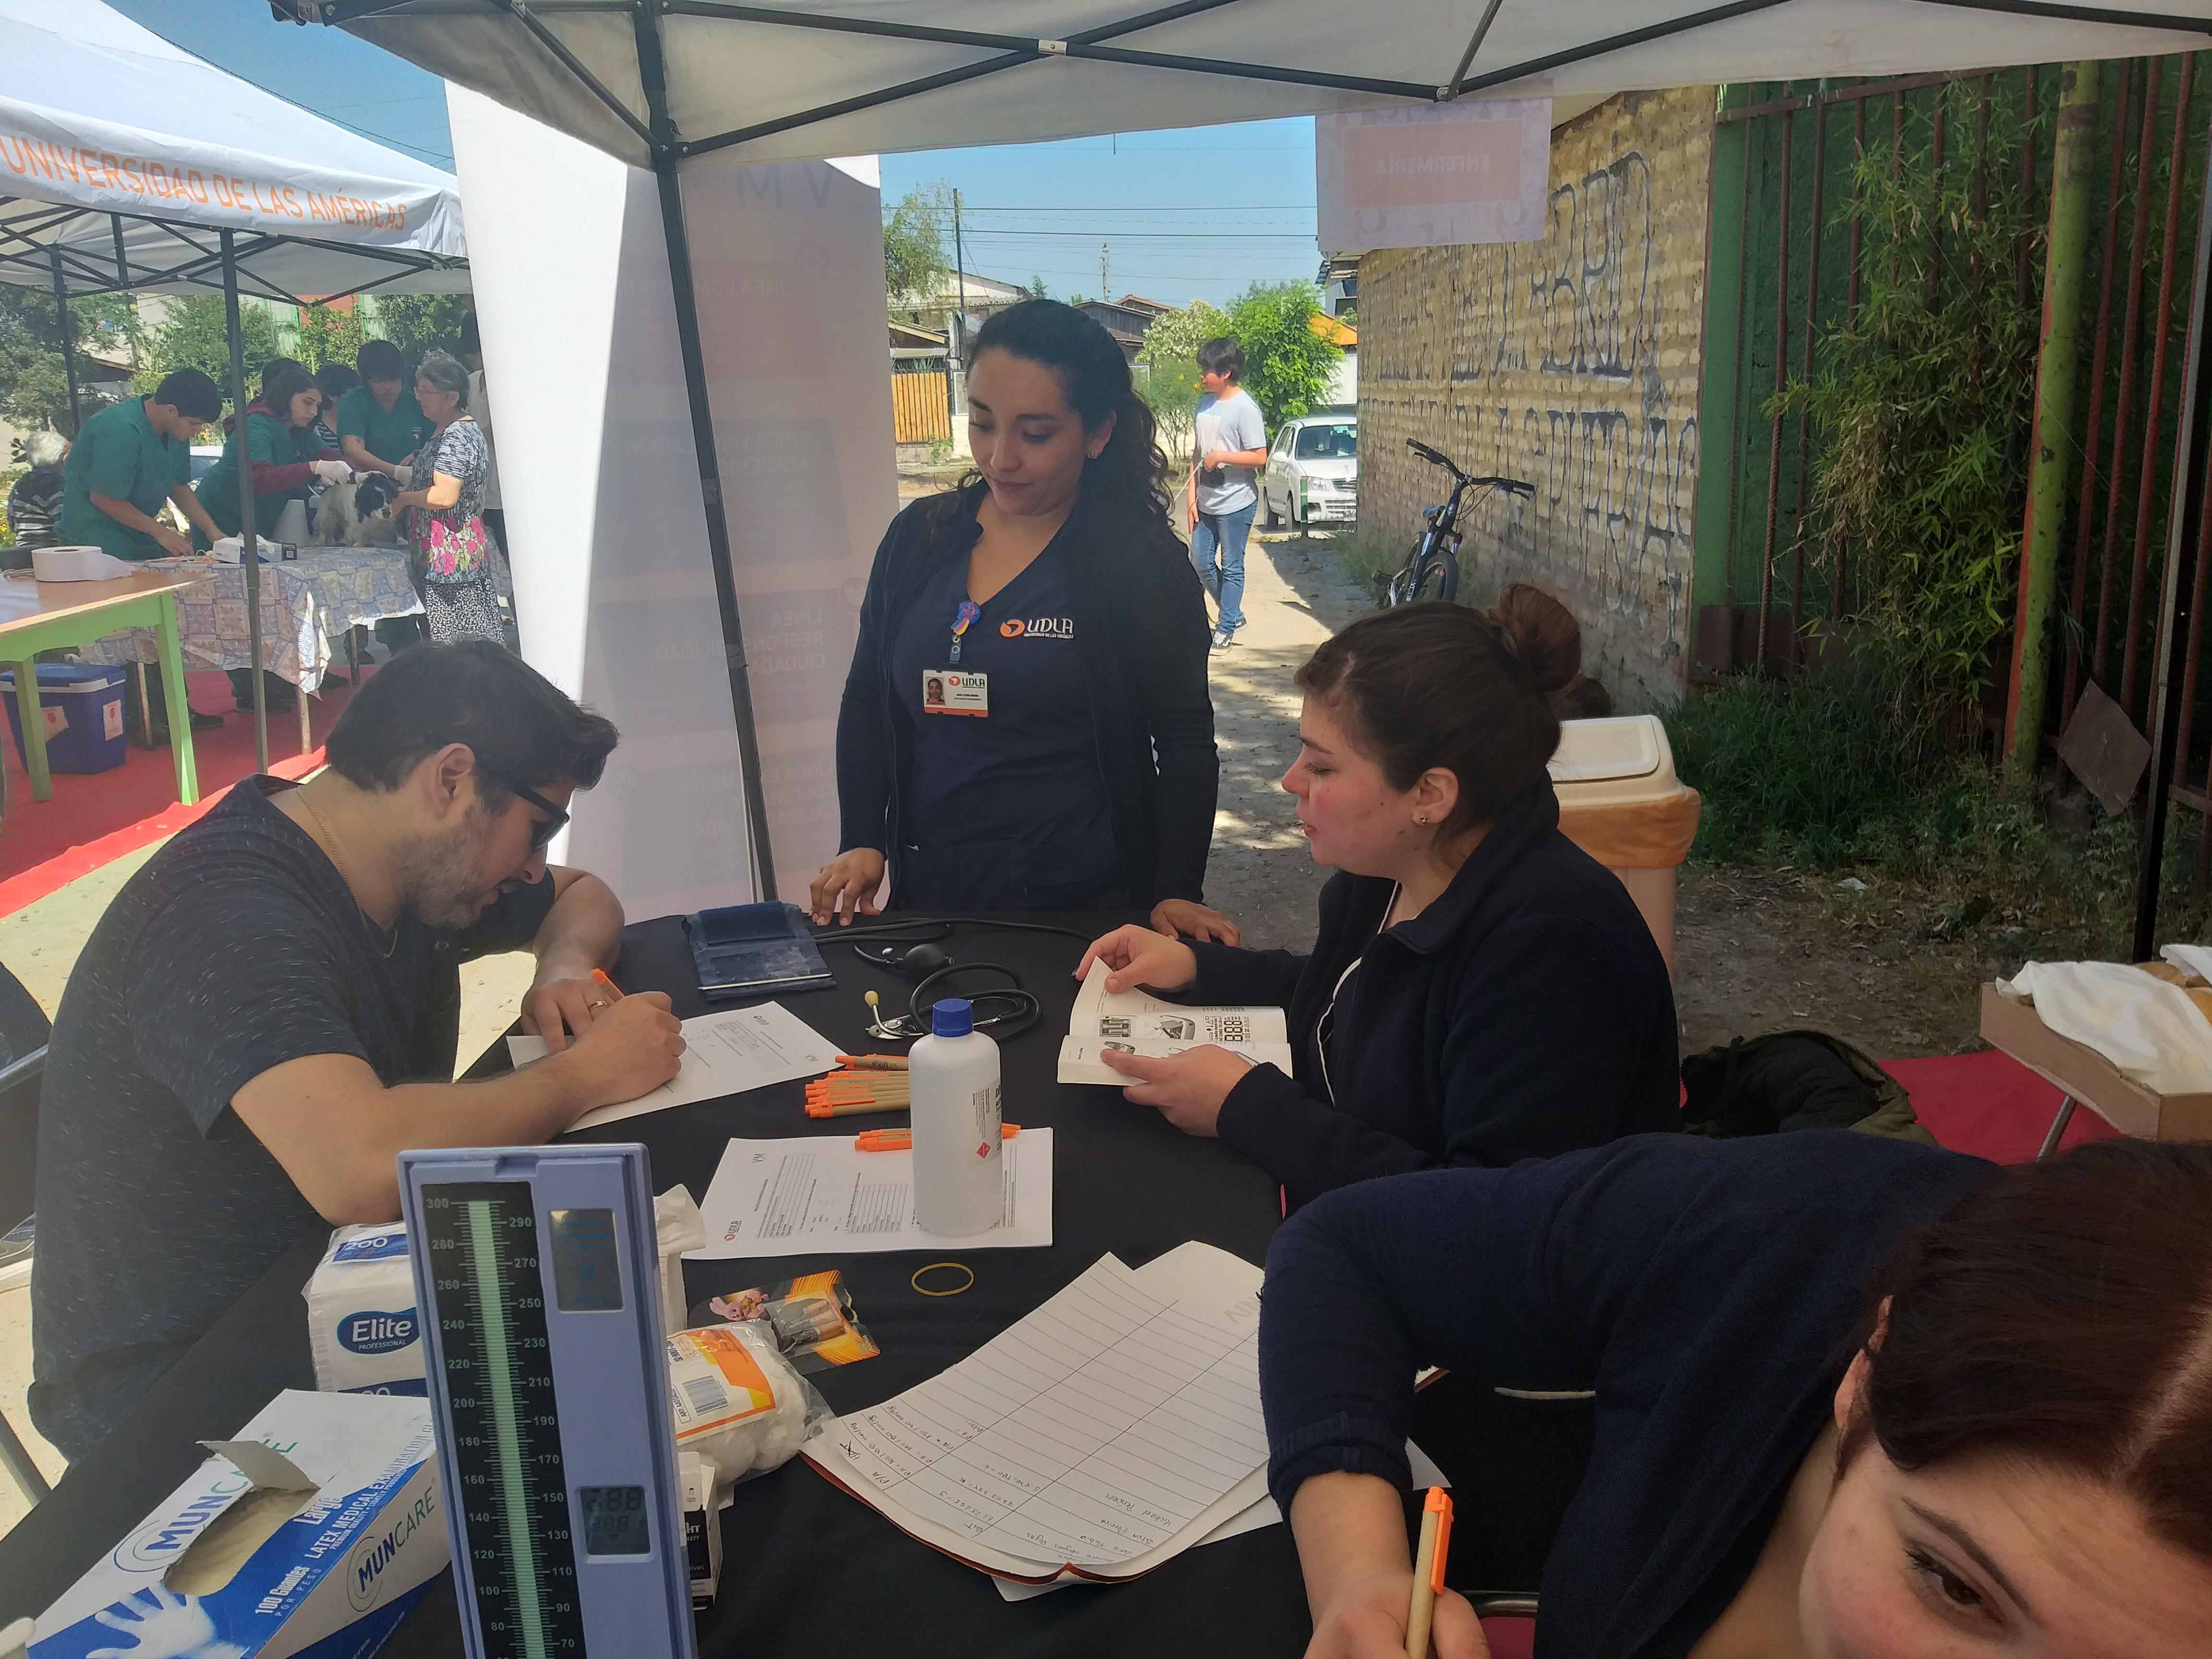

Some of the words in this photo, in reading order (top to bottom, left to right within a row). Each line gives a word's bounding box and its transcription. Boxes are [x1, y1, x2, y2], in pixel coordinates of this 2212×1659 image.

[0, 136, 208, 204] UNIVERSIDAD
[213, 174, 252, 211] DE
[251, 182, 303, 218] LAS
[307, 187, 407, 230] AMÉRICAS
[1027, 618, 1074, 634] UDLA
[962, 677, 986, 687] UDLA
[426, 1199, 449, 1209] 300
[509, 1217, 532, 1227] 290
[432, 1240, 454, 1250] 280
[515, 1258, 537, 1268] 270
[437, 1280, 459, 1290] 260
[519, 1298, 541, 1308] 250
[352, 1317, 412, 1343] Elite
[443, 1320, 465, 1330] 240
[358, 1339, 407, 1351] PROFESSIONAL
[524, 1338, 546, 1348] 230
[448, 1359, 470, 1369] 220
[529, 1378, 550, 1387] 210
[453, 1398, 475, 1408] 200
[533, 1417, 555, 1426] 190
[459, 1437, 480, 1447] 180
[538, 1455, 559, 1465] 170
[464, 1475, 485, 1485] 160
[304, 1530, 342, 1560] LATEX
[331, 1493, 378, 1529] MEDICAL
[368, 1435, 429, 1491] EXAMINATION
[543, 1493, 564, 1503] 150
[293, 1497, 344, 1525] Large
[469, 1513, 490, 1522] 140
[329, 1528, 353, 1550] PREMIUM
[348, 1511, 369, 1529] QUALITY
[547, 1531, 568, 1540] 130
[358, 1486, 435, 1593] MUNCARE
[474, 1550, 495, 1560] 120
[553, 1567, 572, 1576] 110
[254, 1597, 283, 1614] 100
[269, 1565, 311, 1597] Guantes
[275, 1599, 296, 1617] POR
[296, 1568, 321, 1592] PESO
[480, 1587, 500, 1596] 100
[556, 1603, 570, 1612] 90
[491, 1623, 505, 1631] 80
[561, 1639, 575, 1648] 70
